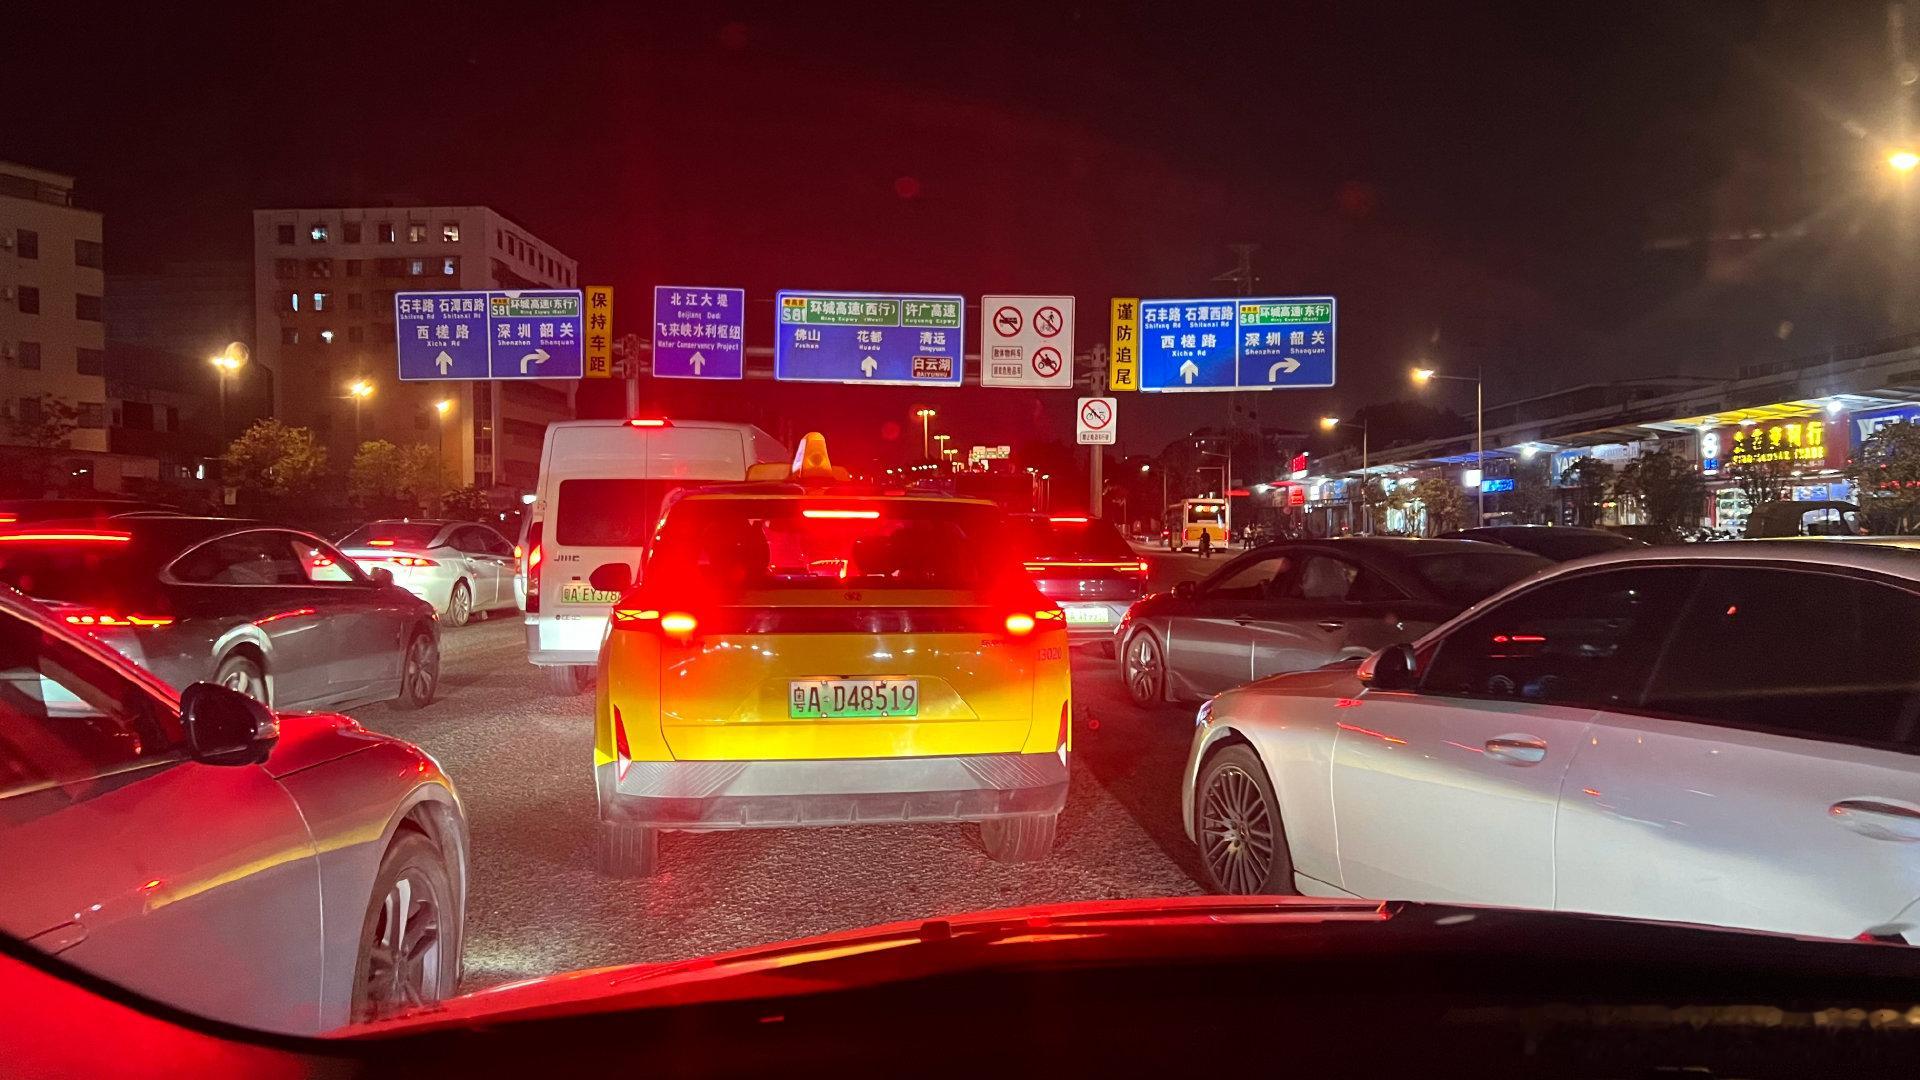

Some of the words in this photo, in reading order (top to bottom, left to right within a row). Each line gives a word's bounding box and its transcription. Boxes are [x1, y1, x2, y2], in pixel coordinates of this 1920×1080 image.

[400, 299, 434, 313] 石丰路
[439, 298, 485, 313] 石潭西路
[671, 293, 728, 307] 北江大堤
[906, 303, 956, 318] 许广高速
[1145, 308, 1180, 322] 石丰路
[1185, 306, 1233, 321] 石潭西路
[416, 324, 470, 340] 西槎路
[498, 324, 531, 338] 深圳
[540, 322, 574, 338] 韶关
[590, 292, 607, 372] 保持车距
[657, 322, 740, 340] 飞来峡水利枢纽
[794, 328, 820, 341] 佛山
[857, 330, 882, 342] 花都
[920, 332, 946, 344] 清远
[1245, 332, 1280, 346] 深圳
[1290, 330, 1324, 346] 韶关
[676, 341, 715, 350] Conservancy
[717, 342, 739, 352] Project
[1116, 304, 1133, 384] 谨防追尾
[1160, 334, 1216, 348] 西槎路
[914, 358, 951, 371] 白云湖
